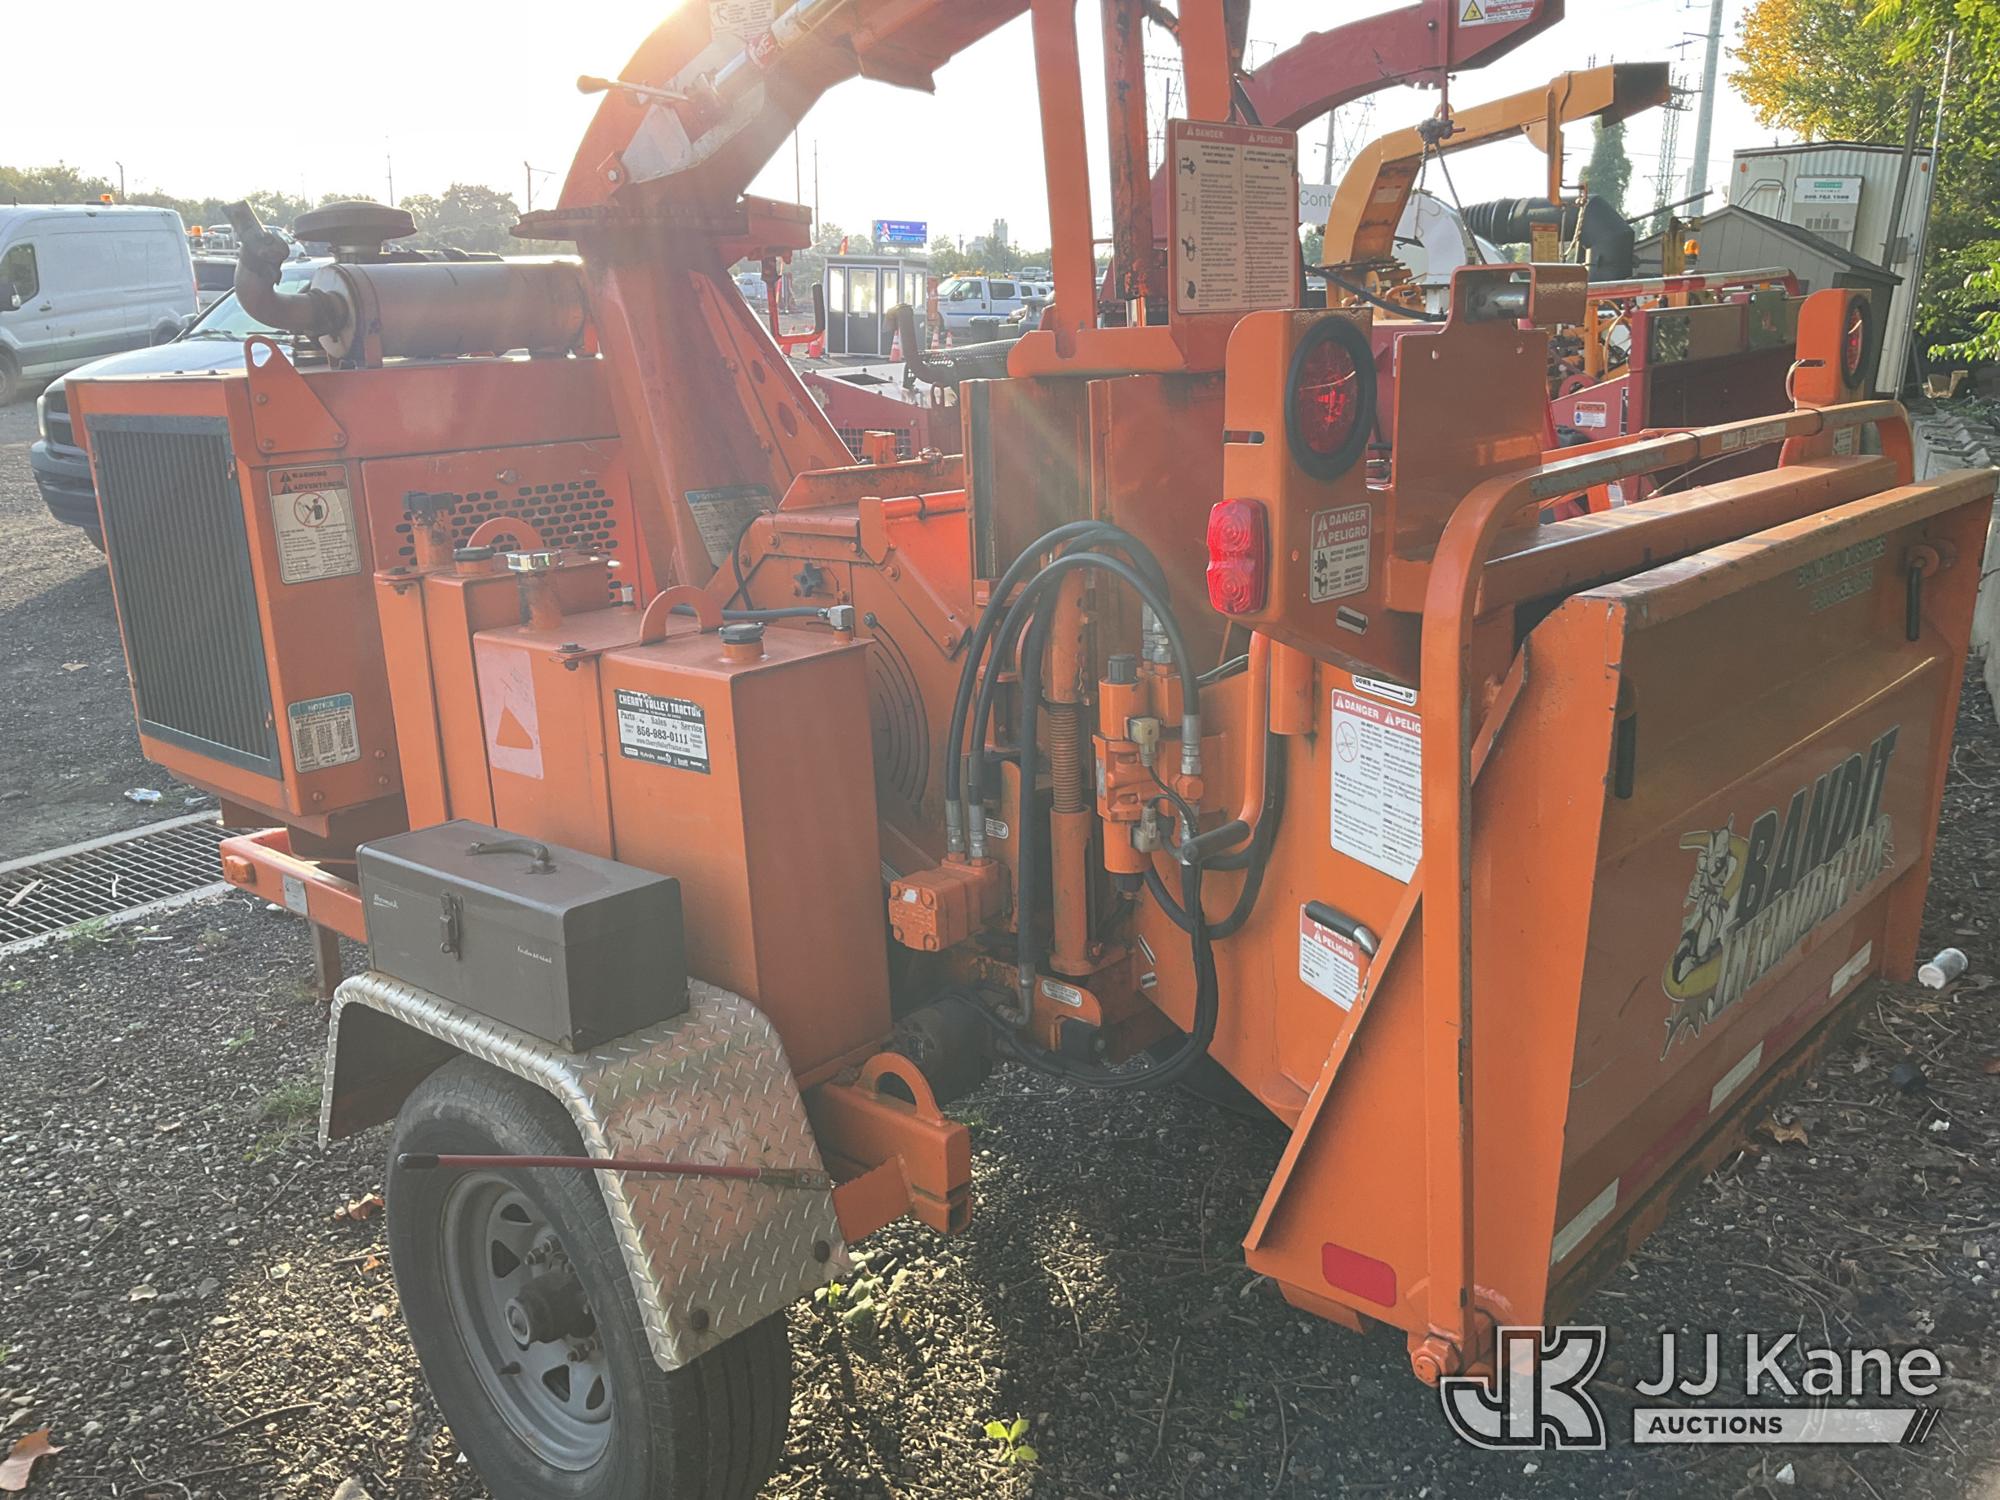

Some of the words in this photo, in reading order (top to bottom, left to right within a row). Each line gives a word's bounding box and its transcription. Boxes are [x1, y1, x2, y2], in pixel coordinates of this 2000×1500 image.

[1195, 128, 1224, 139] DANGER
[1256, 135, 1284, 144] PELIGRO
[1299, 190, 1334, 207] Cont
[1328, 509, 1367, 526] DANGER
[1328, 525, 1368, 544] PELIGRO
[1355, 677, 1371, 687] DOWN
[1404, 690, 1413, 699] UP
[618, 694, 643, 708] CHERRY
[643, 698, 669, 712] VALLEY
[669, 703, 702, 718] TRACTOR
[1344, 699, 1380, 719] DANGER
[620, 711, 636, 721] Parts
[650, 716, 667, 727] Sales
[680, 721, 703, 733] Service
[1394, 716, 1421, 734] PELIG
[1734, 724, 1900, 930] BANDIT
[1322, 935, 1354, 961] PELIGRO
